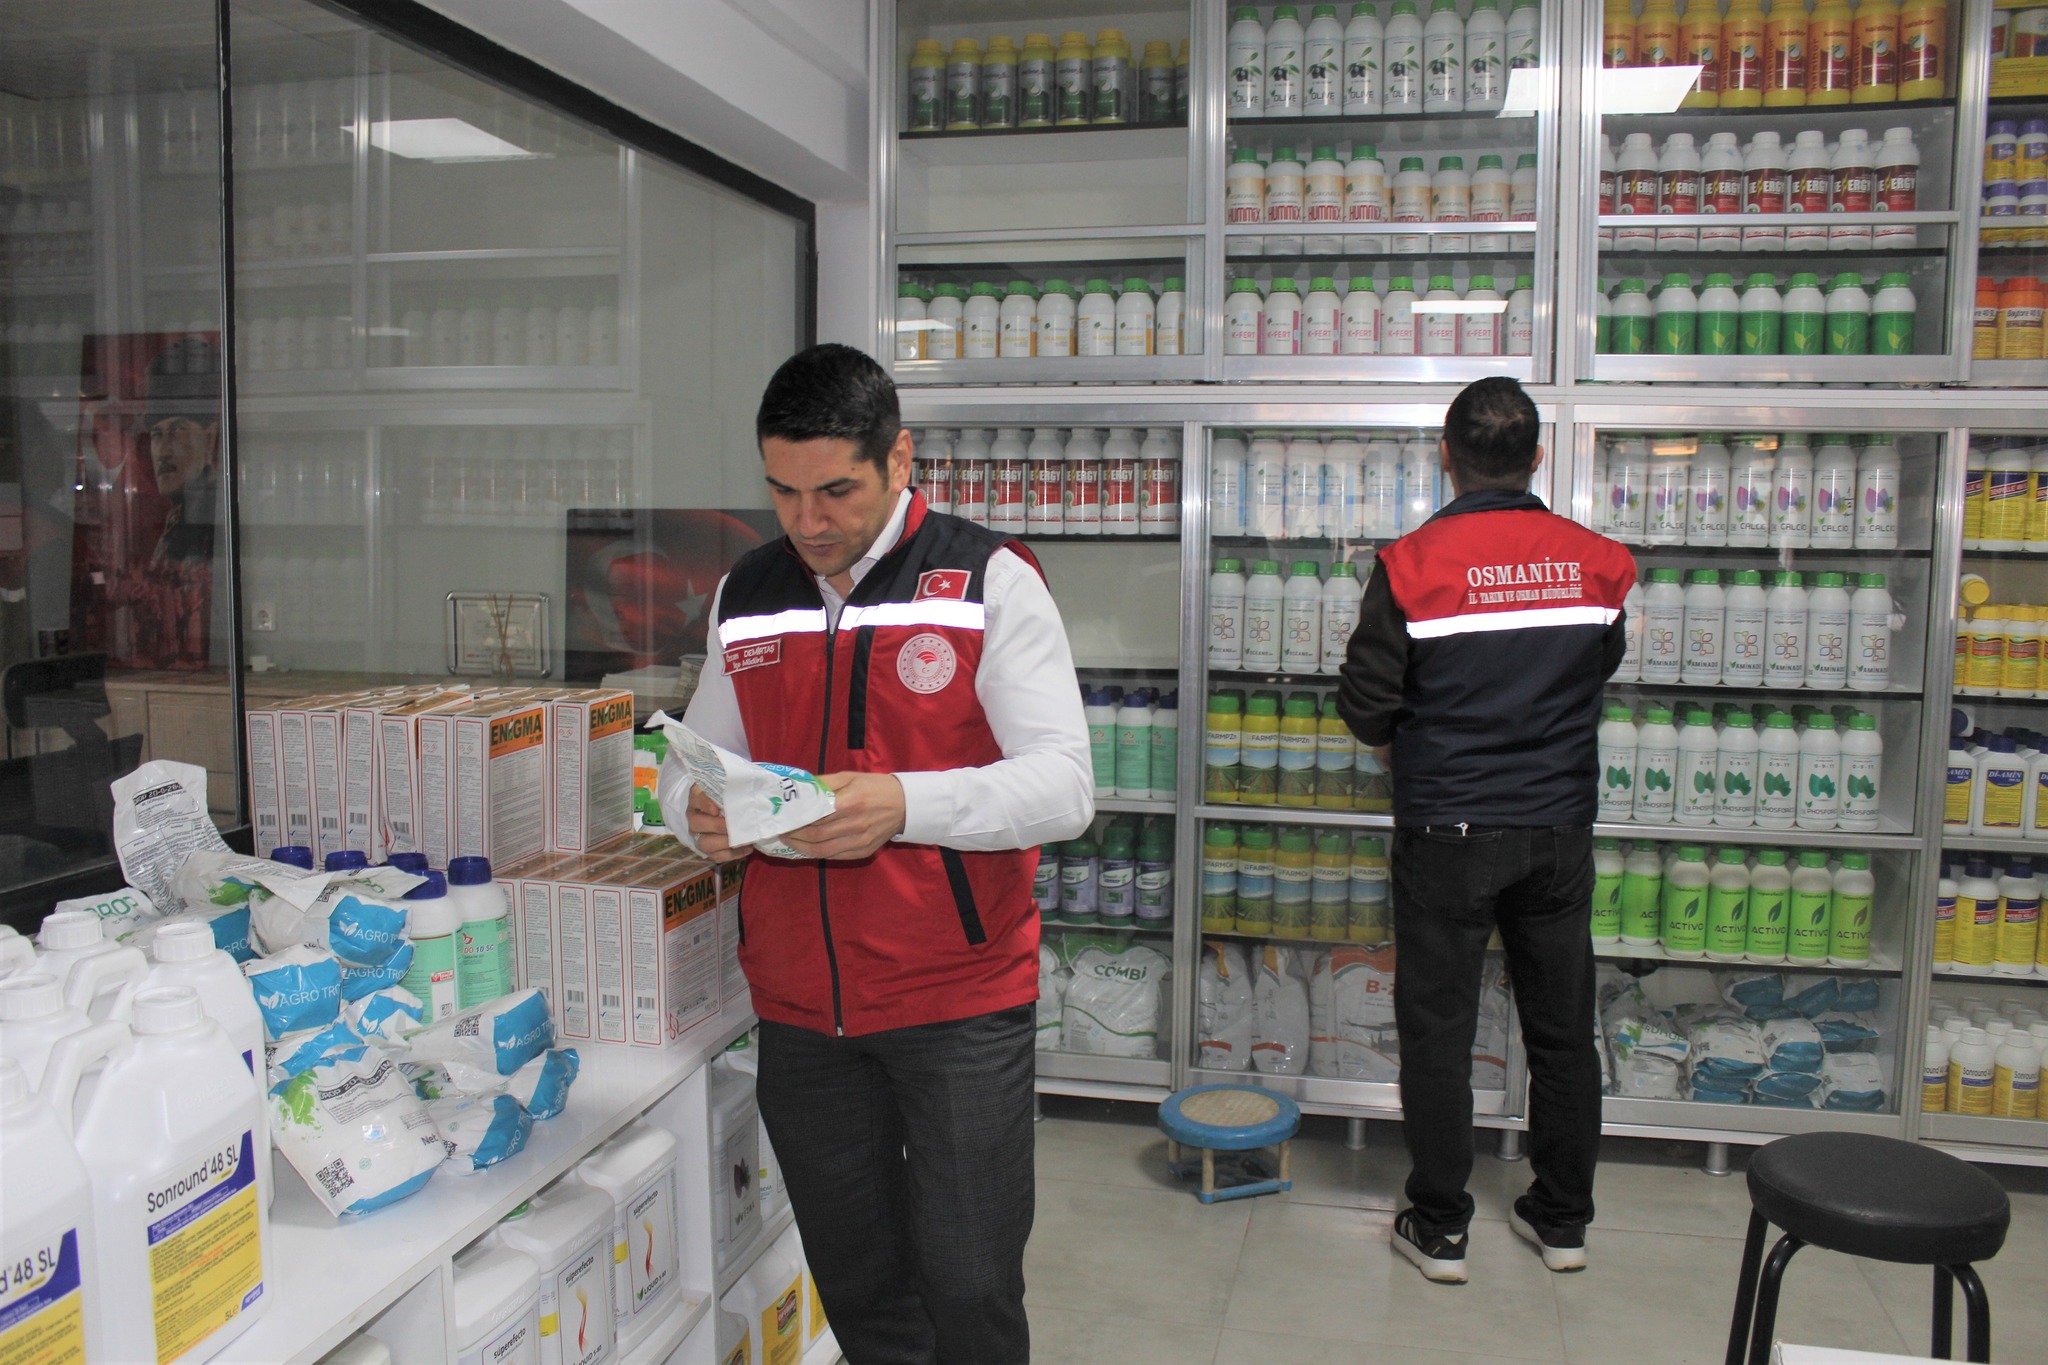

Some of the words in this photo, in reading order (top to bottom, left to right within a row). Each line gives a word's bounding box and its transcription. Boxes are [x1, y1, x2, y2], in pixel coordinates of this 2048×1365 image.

[1512, 330, 1532, 338] K-FER
[1467, 557, 1581, 587] OSMANİYE
[354, 928, 389, 944] AGRO
[221, 938, 250, 954] GRO
[350, 968, 385, 979] AGRO
[279, 990, 319, 1007] AGRO
[515, 1027, 541, 1049] AGRO
[210, 1154, 225, 1176] 48
[227, 1144, 239, 1166] SL
[14, 1258, 34, 1284] 48
[38, 1246, 56, 1273] SL
